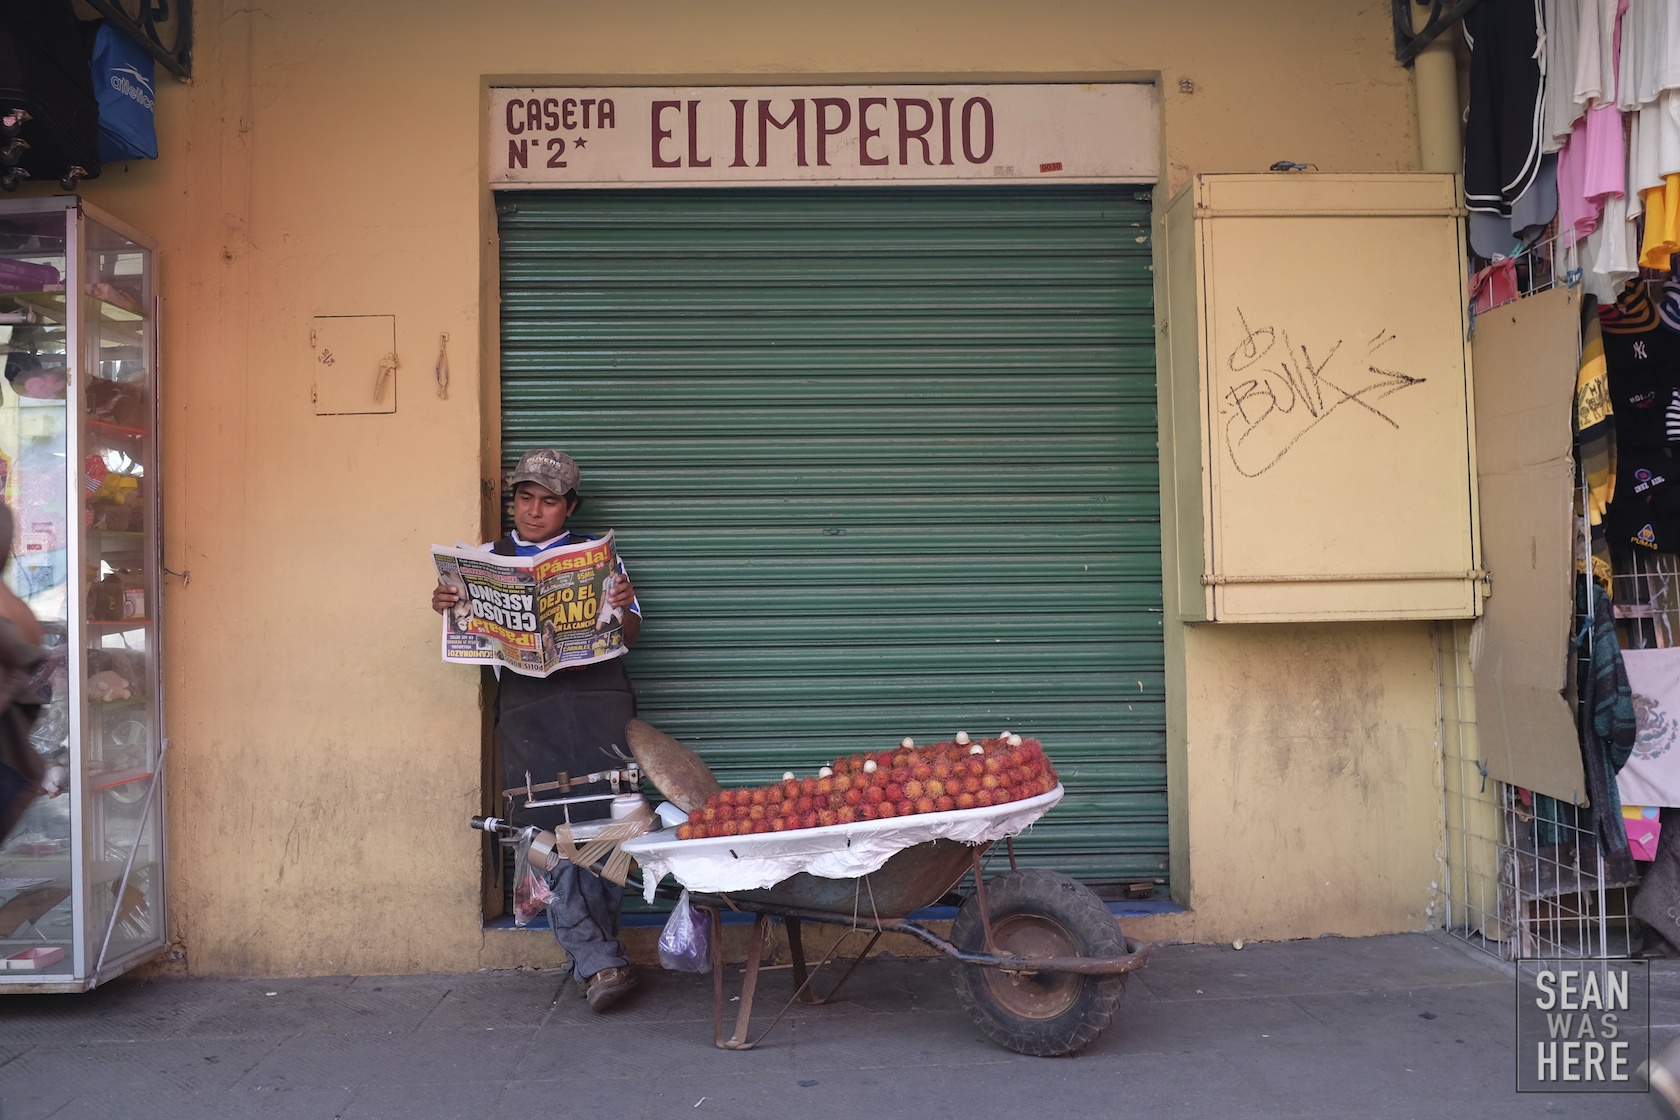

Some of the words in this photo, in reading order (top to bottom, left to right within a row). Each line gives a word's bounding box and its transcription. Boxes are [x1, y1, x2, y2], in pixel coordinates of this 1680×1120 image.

[506, 97, 615, 135] CASETA
[651, 100, 712, 168] EL
[728, 96, 994, 167] IMPERIO
[546, 137, 568, 168] 2
[1042, 163, 1062, 172] 0030
[1633, 340, 1648, 360] NY
[1630, 536, 1658, 550] PUMAS
[536, 547, 609, 579] ¡Pásala!
[469, 583, 533, 611] ASESINO
[539, 588, 573, 613] DEJÓ
[578, 586, 596, 602] EL
[473, 601, 537, 631] CELOSO
[563, 623, 573, 631] LA
[468, 616, 535, 646] ¡Pásala!
